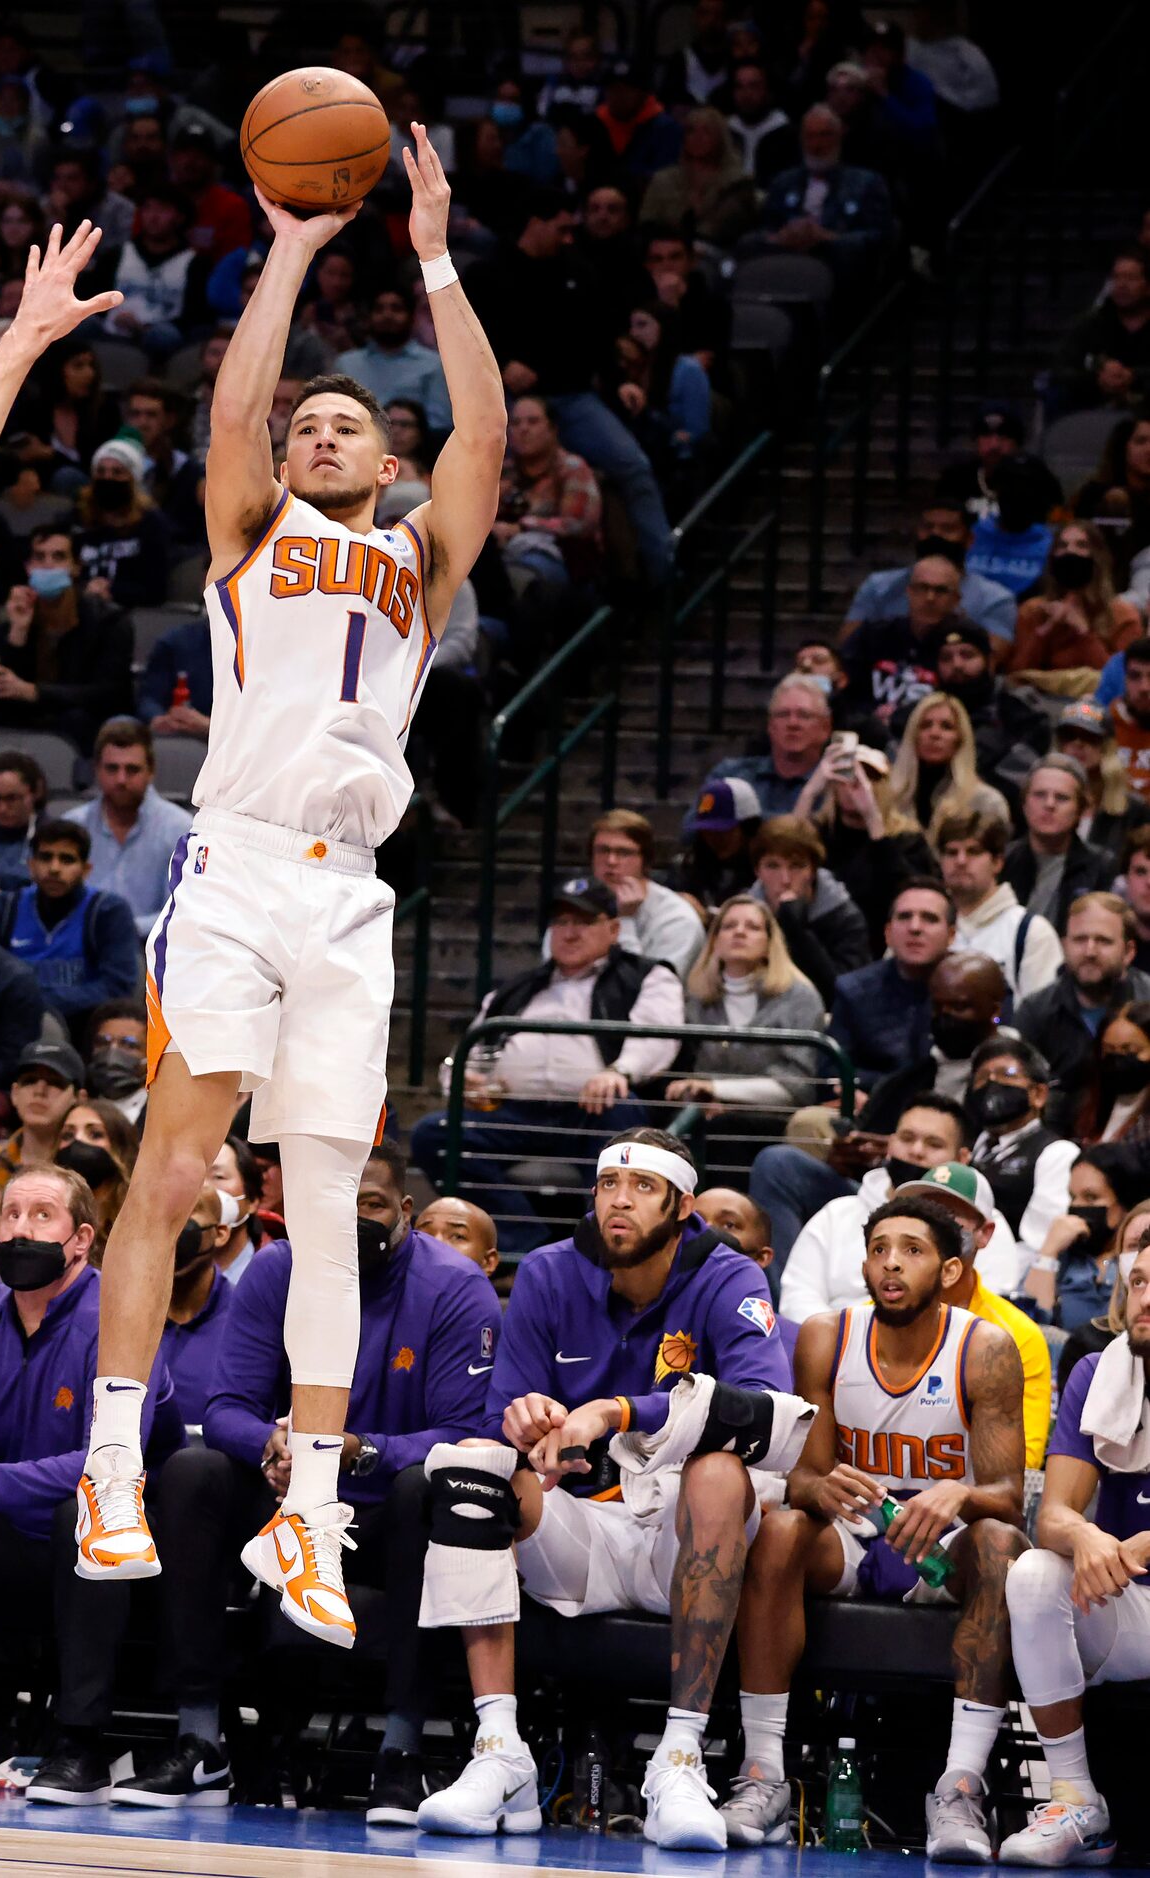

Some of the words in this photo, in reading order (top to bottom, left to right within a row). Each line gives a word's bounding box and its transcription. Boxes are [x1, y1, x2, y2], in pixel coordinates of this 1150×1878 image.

[269, 535, 419, 639] SUNS
[339, 609, 367, 703] 1
[919, 1396, 951, 1406] PayPal
[590, 1763, 603, 1806] essentia
